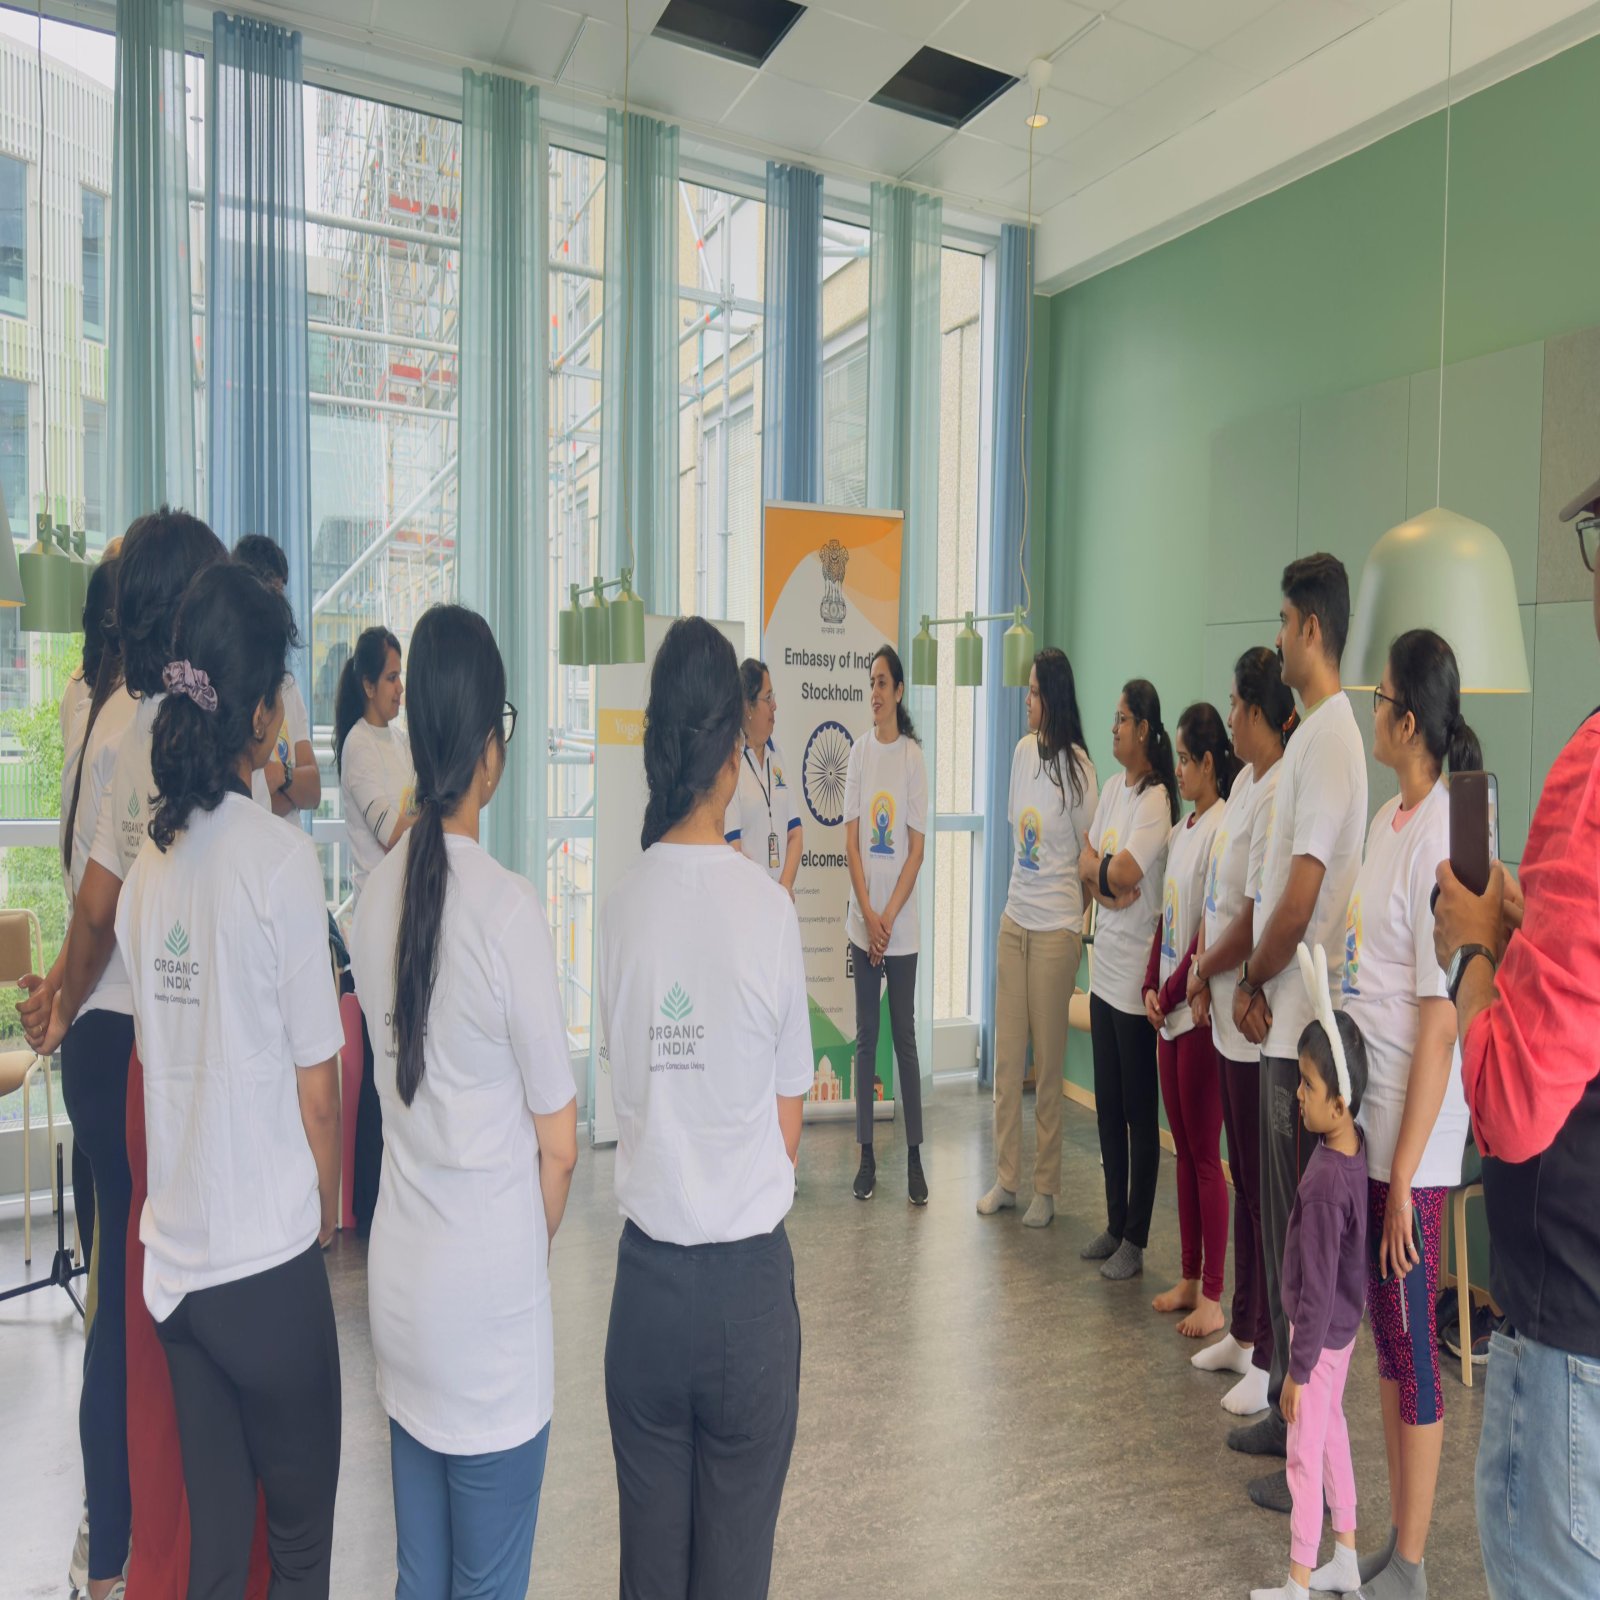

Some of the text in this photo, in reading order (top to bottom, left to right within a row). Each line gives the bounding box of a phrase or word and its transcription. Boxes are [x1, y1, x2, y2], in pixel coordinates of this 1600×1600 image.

[785, 647, 875, 671] Embassy of Indi
[801, 682, 863, 702] Stockholm
[121, 821, 143, 834] ORGANIC
[801, 850, 848, 867] elcomes
[154, 958, 200, 976] ORGANIC
[163, 976, 191, 991] INDIA
[649, 1025, 705, 1041] ORGANIC
[658, 1041, 695, 1057] INDIA
[665, 1061, 690, 1071] Conscious
[690, 1061, 705, 1072] Living
